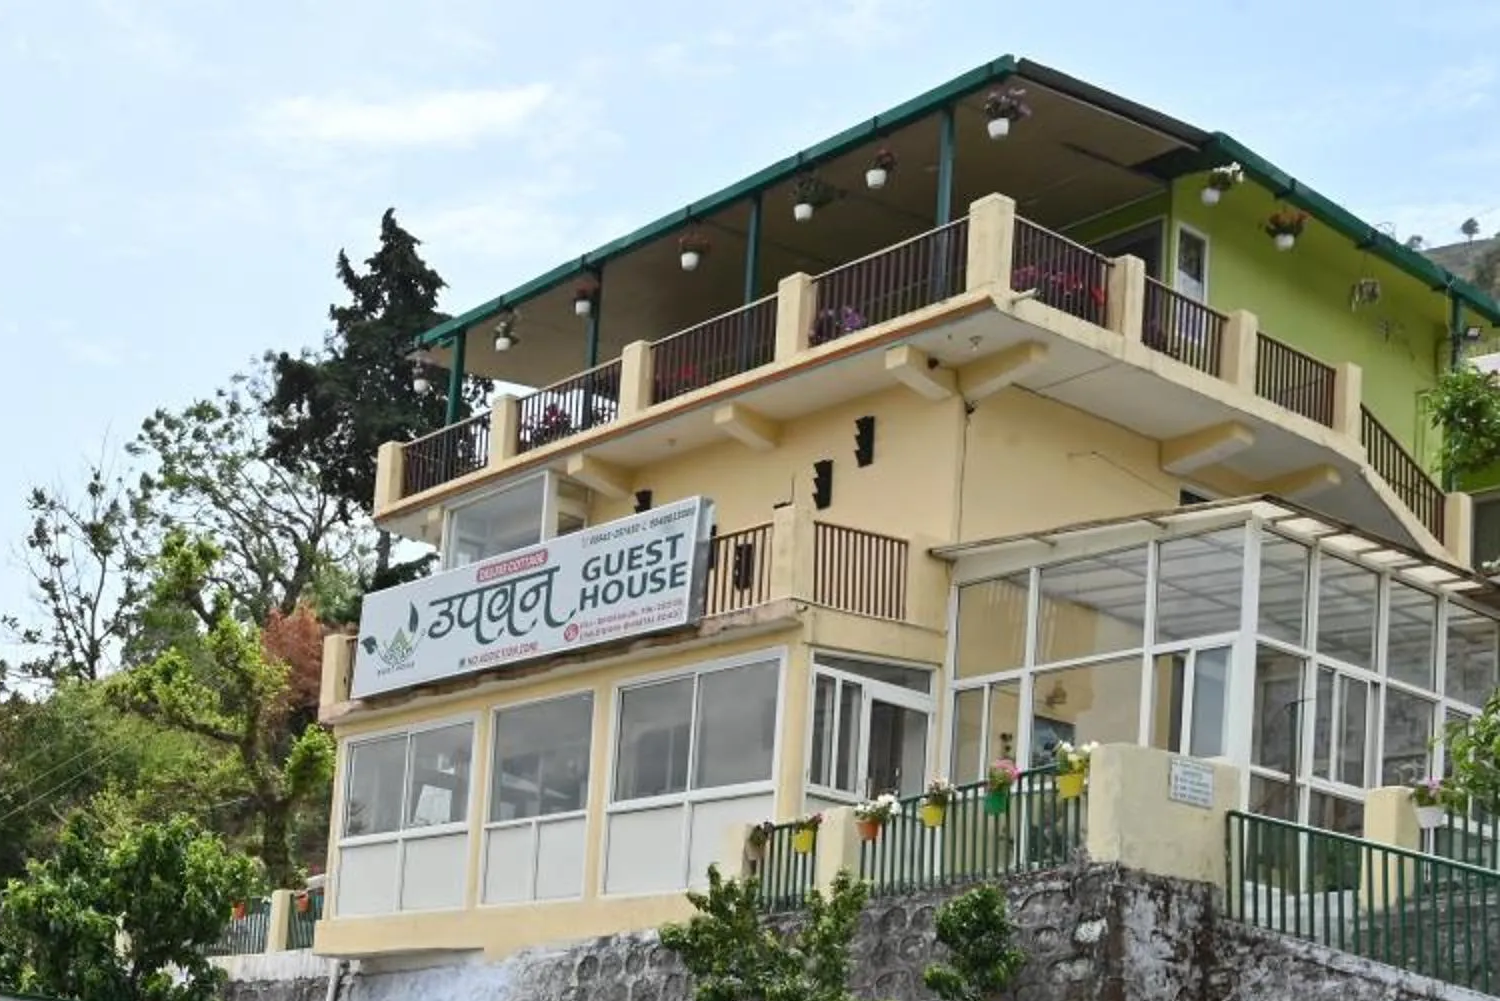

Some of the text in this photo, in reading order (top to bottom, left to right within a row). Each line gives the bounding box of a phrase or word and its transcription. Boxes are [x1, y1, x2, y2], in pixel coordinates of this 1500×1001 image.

[581, 532, 685, 582] GUEST
[428, 565, 576, 645] उपवन
[579, 561, 688, 611] HOUSE
